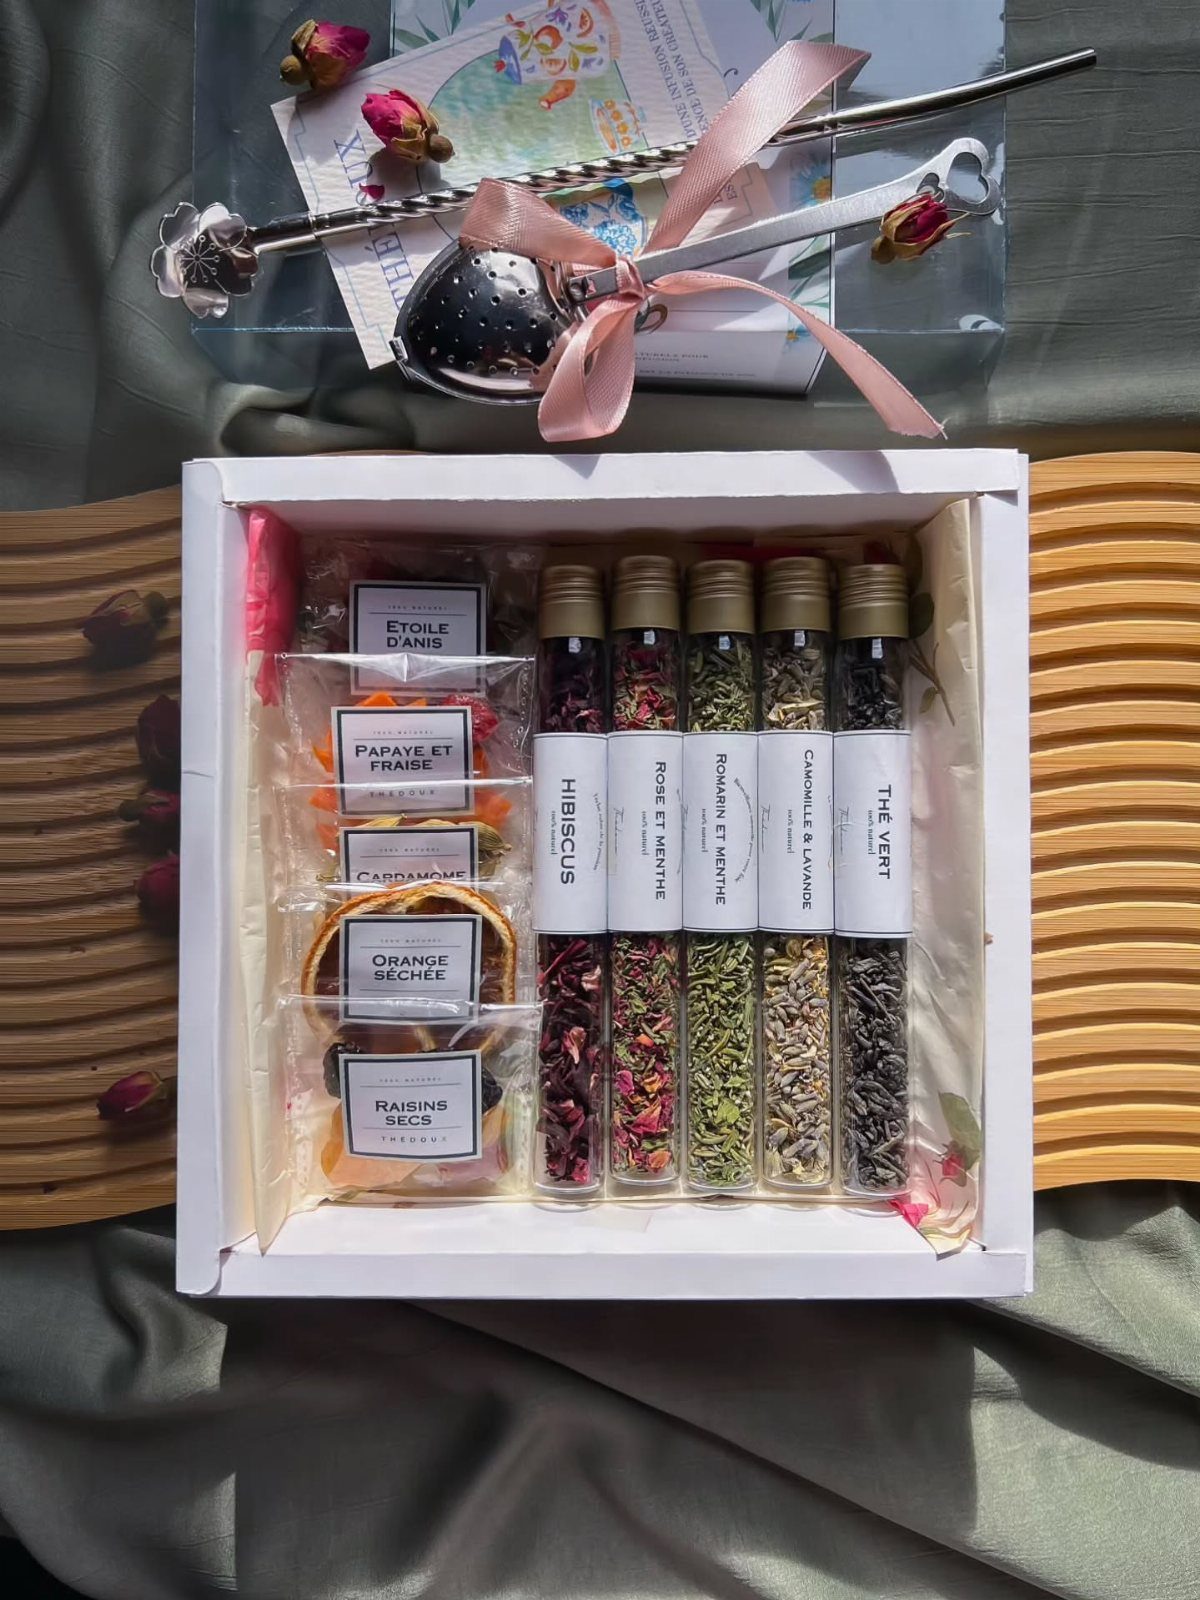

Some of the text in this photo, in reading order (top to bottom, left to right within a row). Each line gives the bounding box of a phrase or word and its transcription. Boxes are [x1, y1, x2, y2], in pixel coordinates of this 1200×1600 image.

[672, 54, 689, 77] SON
[682, 79, 696, 97] DE
[386, 620, 450, 635] ETOILE
[386, 635, 443, 649] D'ANIS
[355, 745, 453, 758] PAPAYE ET
[370, 759, 433, 772] FRAISE
[560, 778, 576, 884] HIBISCUS
[655, 761, 667, 900] ROSE ET MENTHE
[715, 753, 727, 905] ROMARIN ET MENTHE
[802, 749, 814, 910] CAMOMILLE & LAVANDE
[878, 784, 893, 880] THÉ VERT
[372, 954, 449, 967] ORANGE
[374, 967, 446, 981] SÉCHÉE
[375, 1100, 448, 1112] RAISINS
[385, 1115, 432, 1126] SECS
